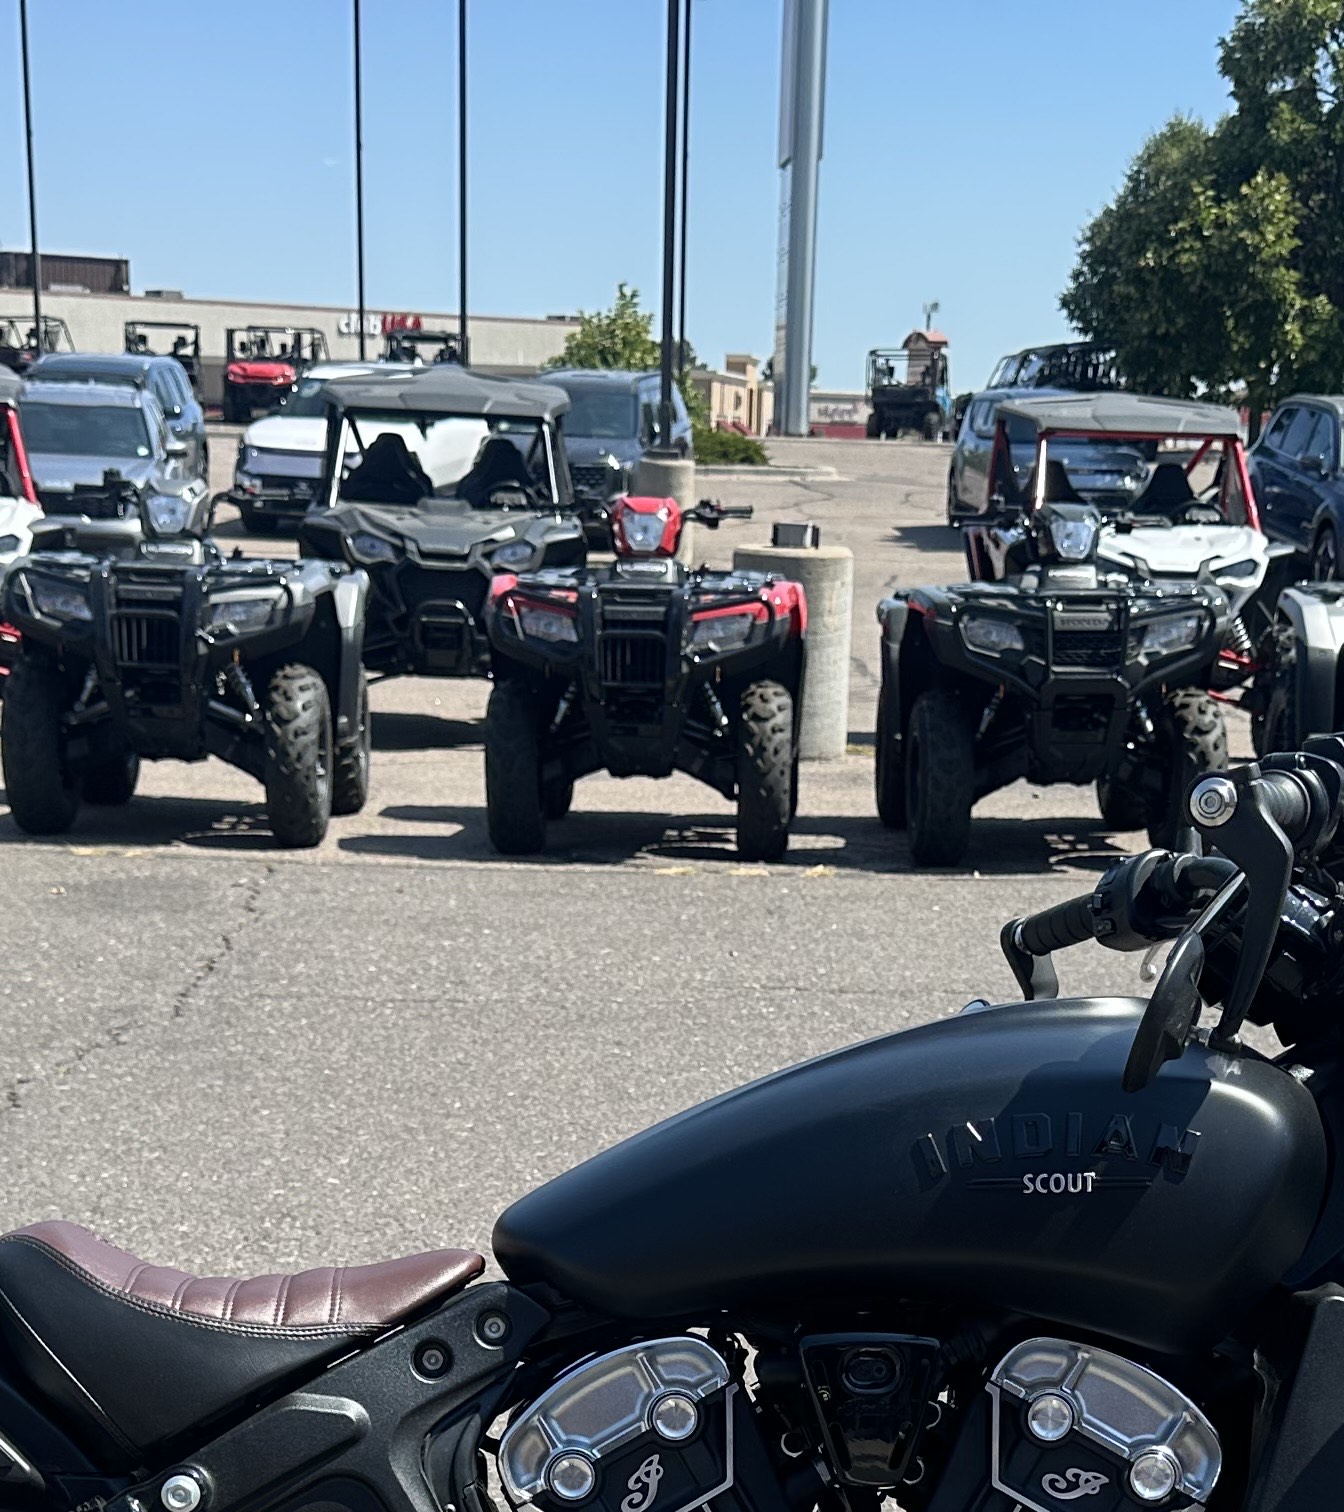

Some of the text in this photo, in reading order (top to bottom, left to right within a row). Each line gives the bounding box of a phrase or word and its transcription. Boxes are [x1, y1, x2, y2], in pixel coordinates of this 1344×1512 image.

[1059, 618, 1111, 627] HONDA
[914, 1112, 1202, 1183] INDIAN
[1022, 1172, 1096, 1194] SCOUT
